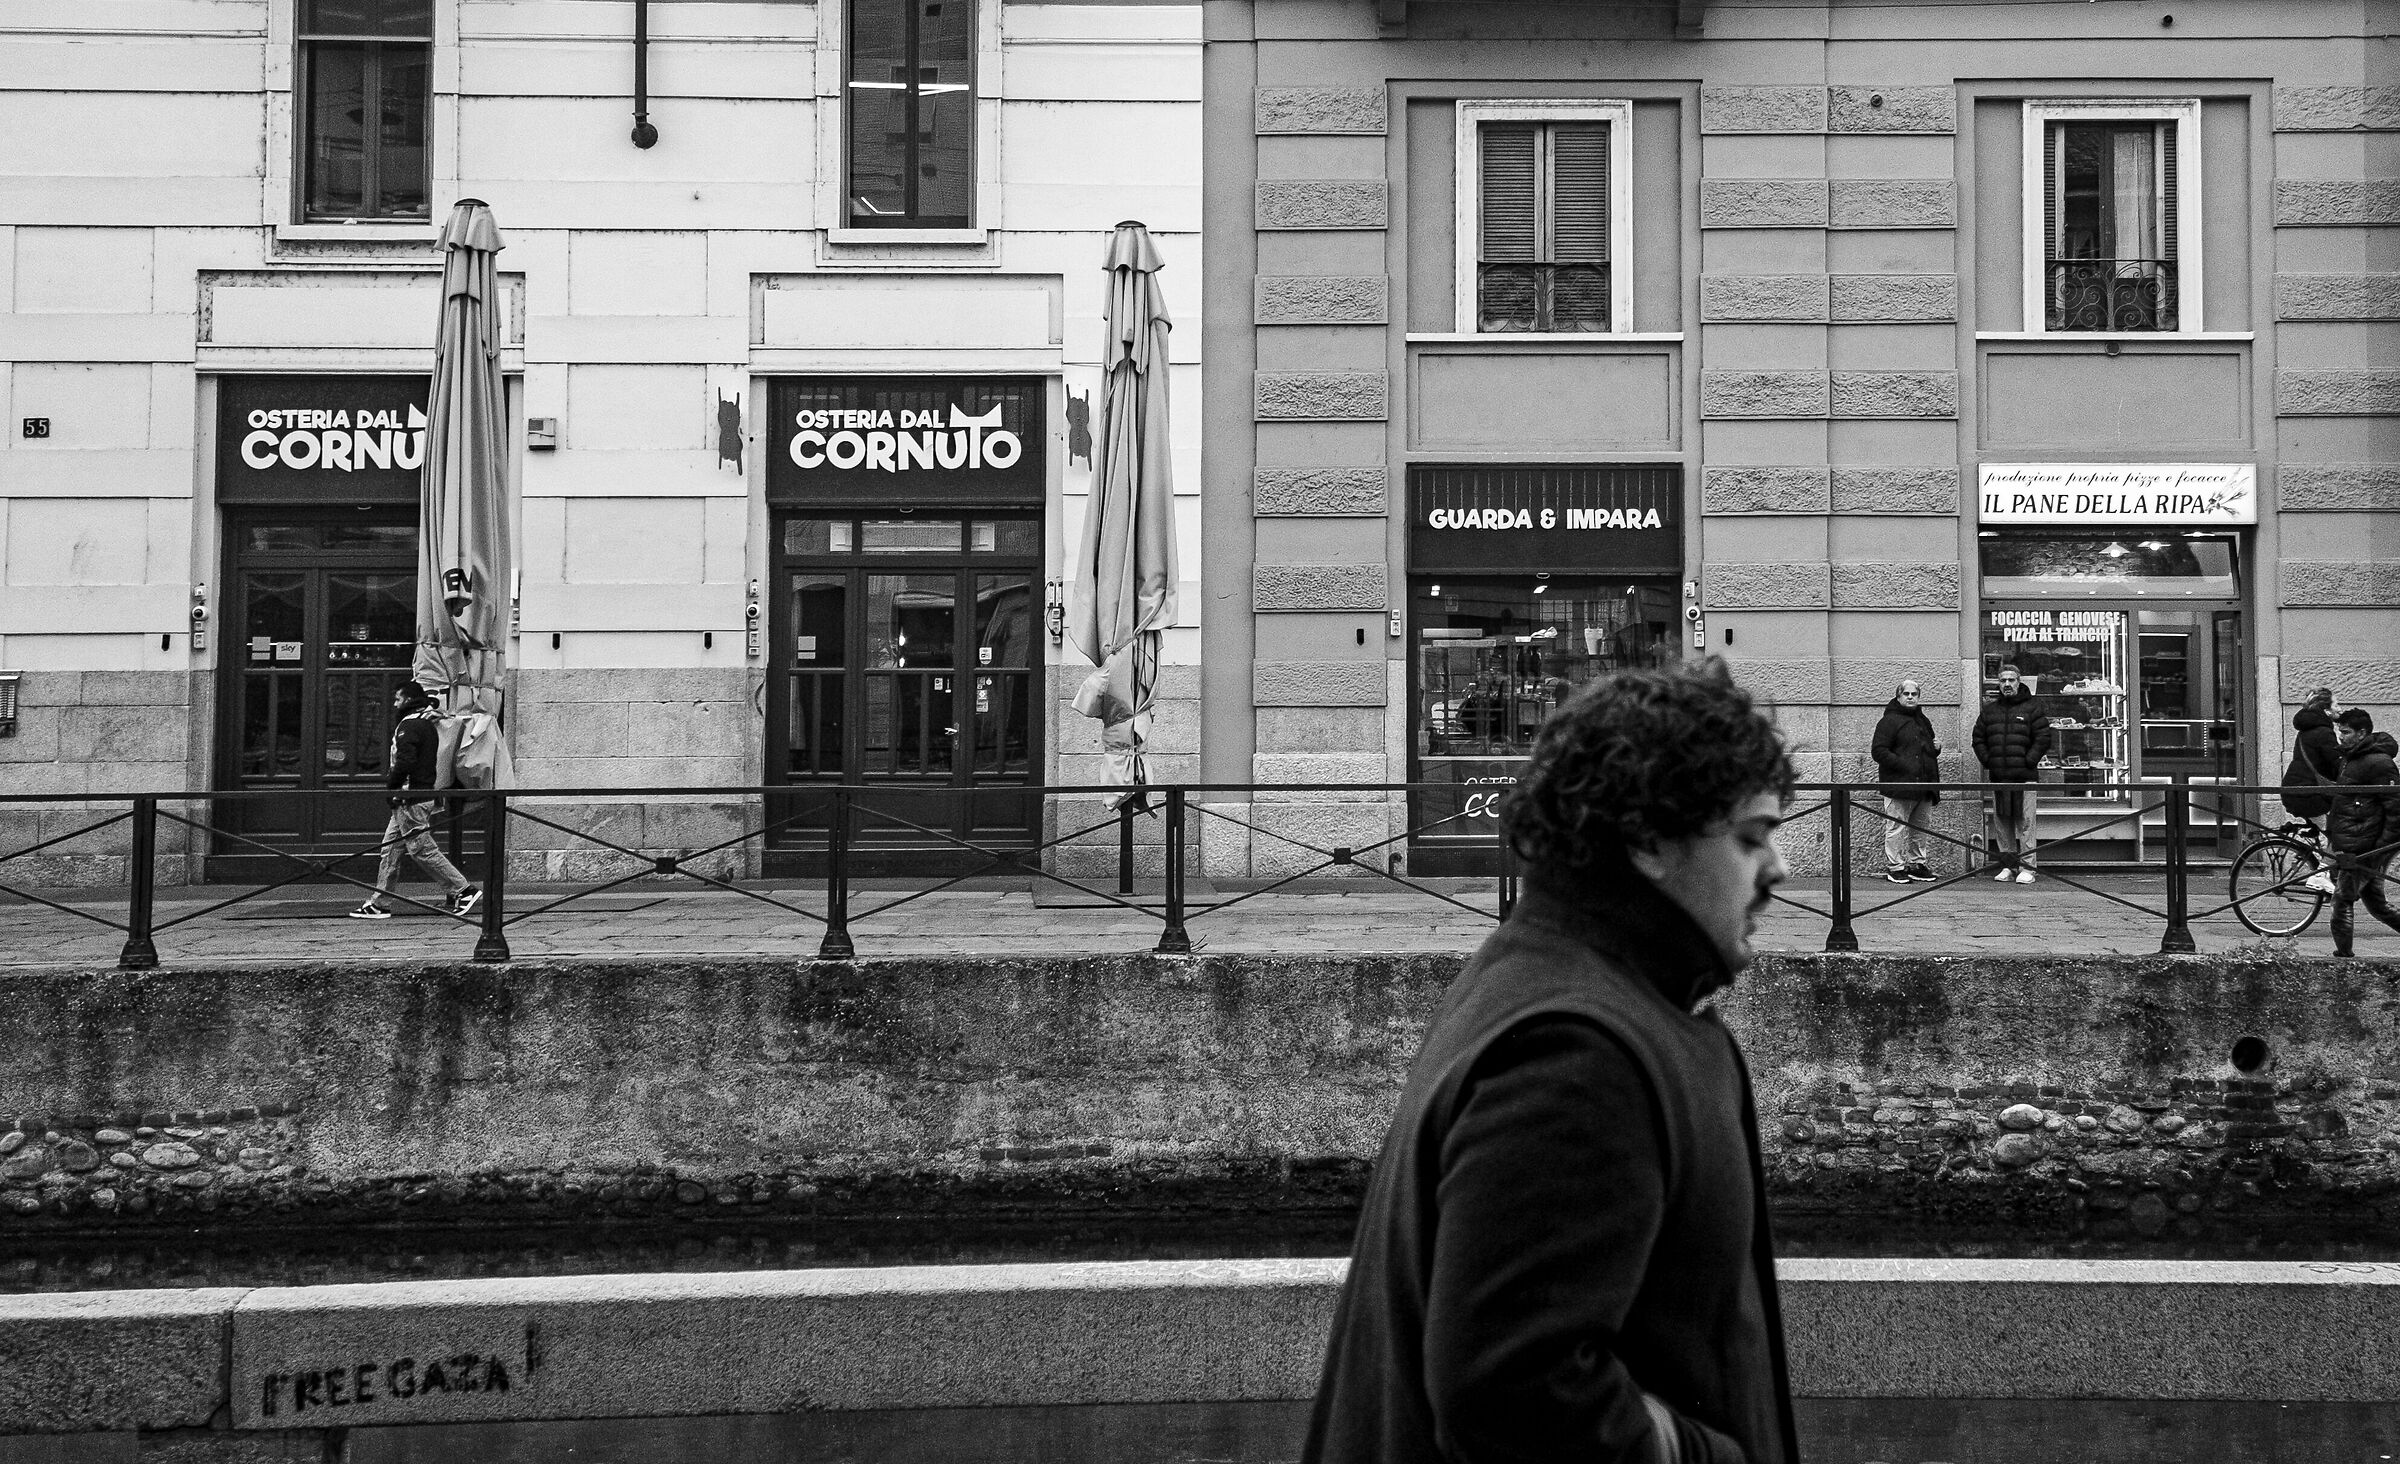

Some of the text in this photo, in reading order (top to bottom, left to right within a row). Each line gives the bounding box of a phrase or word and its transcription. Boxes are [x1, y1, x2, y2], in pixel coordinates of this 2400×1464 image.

[26, 419, 47, 435] 55
[248, 409, 403, 429] OSTERIA DAL
[796, 409, 945, 429] OSTERIA DAL
[789, 403, 1022, 473] CORNUTO
[241, 430, 426, 473] CORNU
[1984, 470, 2062, 487] produzione
[2065, 472, 2119, 486] propria
[2122, 472, 2160, 487] pizze
[2175, 470, 2226, 488] focacce
[1984, 494, 2205, 514] IL PANE DELLA RIPA
[1428, 508, 1661, 531] GUARDA & IMPARA
[1991, 611, 2120, 626] FOCACCIA GENOVESE
[2003, 627, 2109, 642] PIZZA AL TRANCIO
[281, 644, 296, 654] sky
[262, 1362, 378, 1416] FREE
[387, 1353, 511, 1400] GAZA
